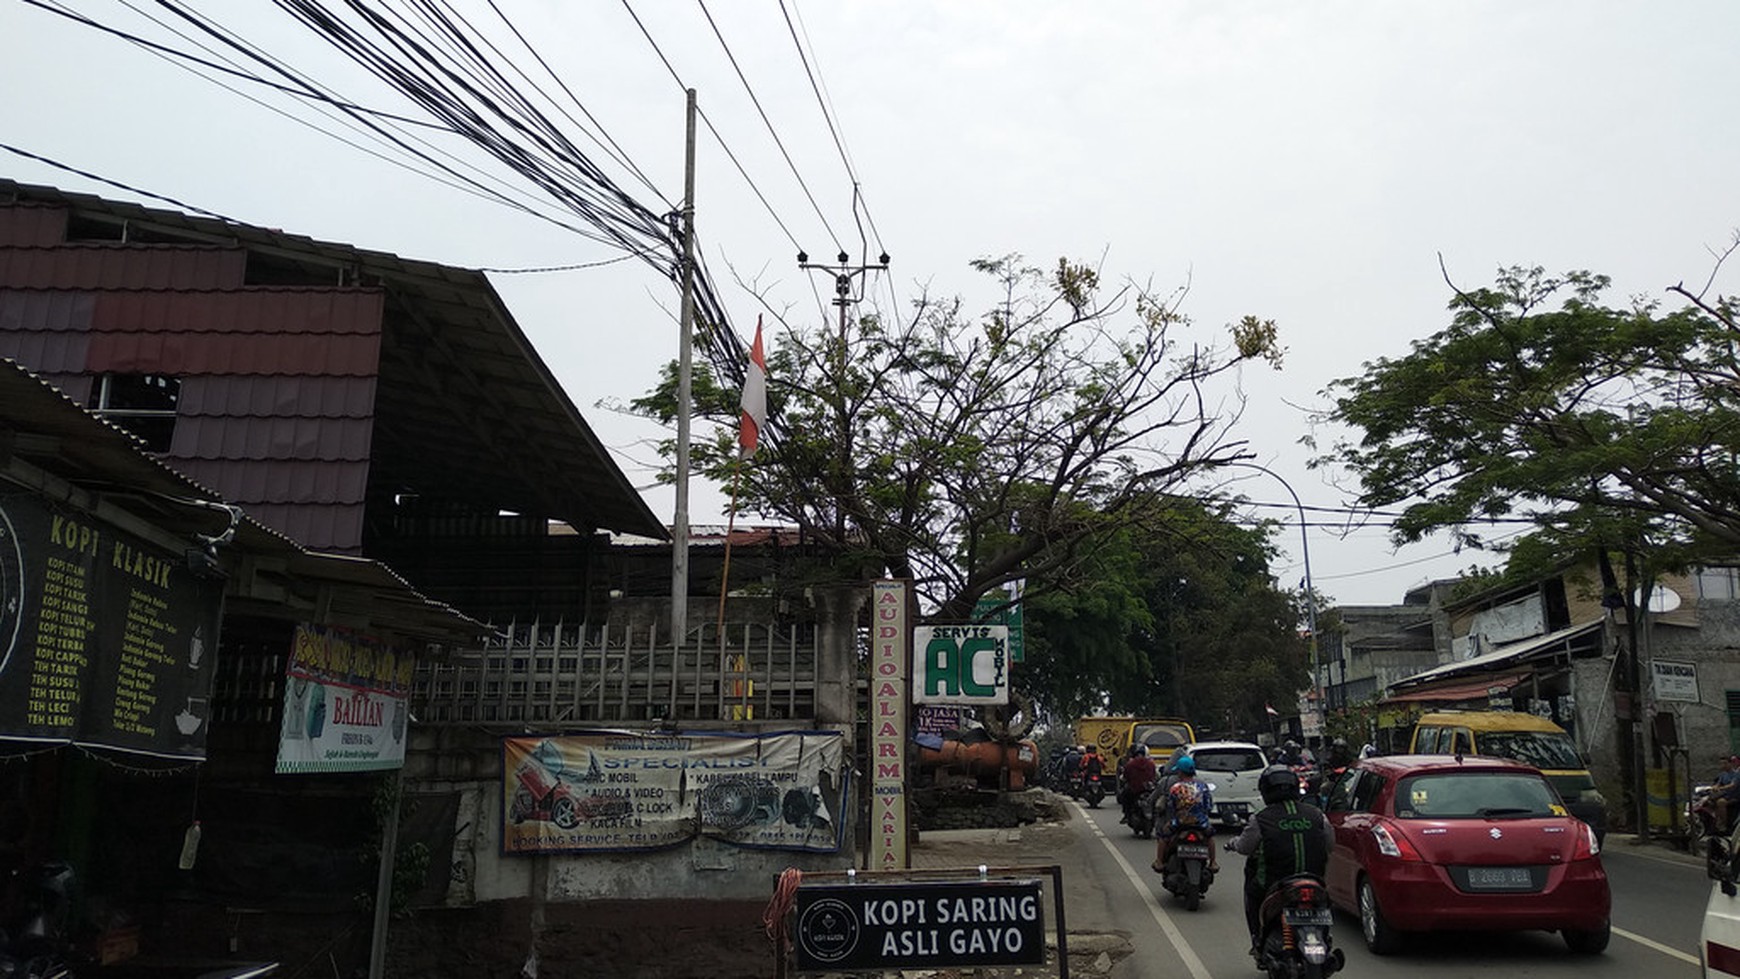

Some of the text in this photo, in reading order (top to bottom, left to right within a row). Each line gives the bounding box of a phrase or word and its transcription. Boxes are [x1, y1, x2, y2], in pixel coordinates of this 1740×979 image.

[50, 514, 172, 589] KOPI KLASIK
[48, 557, 65, 571] KOPI
[46, 570, 64, 583] KOPI
[44, 583, 63, 596] KOPI
[42, 595, 61, 609] KOPI
[40, 609, 59, 621] KOPI
[38, 622, 57, 634] KOPI
[878, 592, 897, 675] AUDIO
[932, 628, 990, 638] SERVIS
[37, 635, 56, 647] KOPI
[35, 648, 54, 660] KOPI
[34, 661, 48, 672] TEH
[925, 639, 995, 697] AC
[994, 639, 1005, 687] MOBIL
[32, 674, 48, 685] TEH
[31, 687, 47, 698] TEH
[29, 700, 45, 711] TEH
[27, 714, 45, 724] TEH
[877, 683, 900, 778] ALARM
[608, 773, 639, 783] MOBIL
[591, 788, 664, 798] AUDIO & VIDEO
[875, 787, 903, 795] MOBIL
[646, 803, 673, 813] LOCK
[1279, 818, 1313, 831] Grab
[570, 834, 620, 844] SERVICE
[863, 895, 1037, 926] KOPI SARING
[881, 927, 1023, 957] ASLI GAYO
